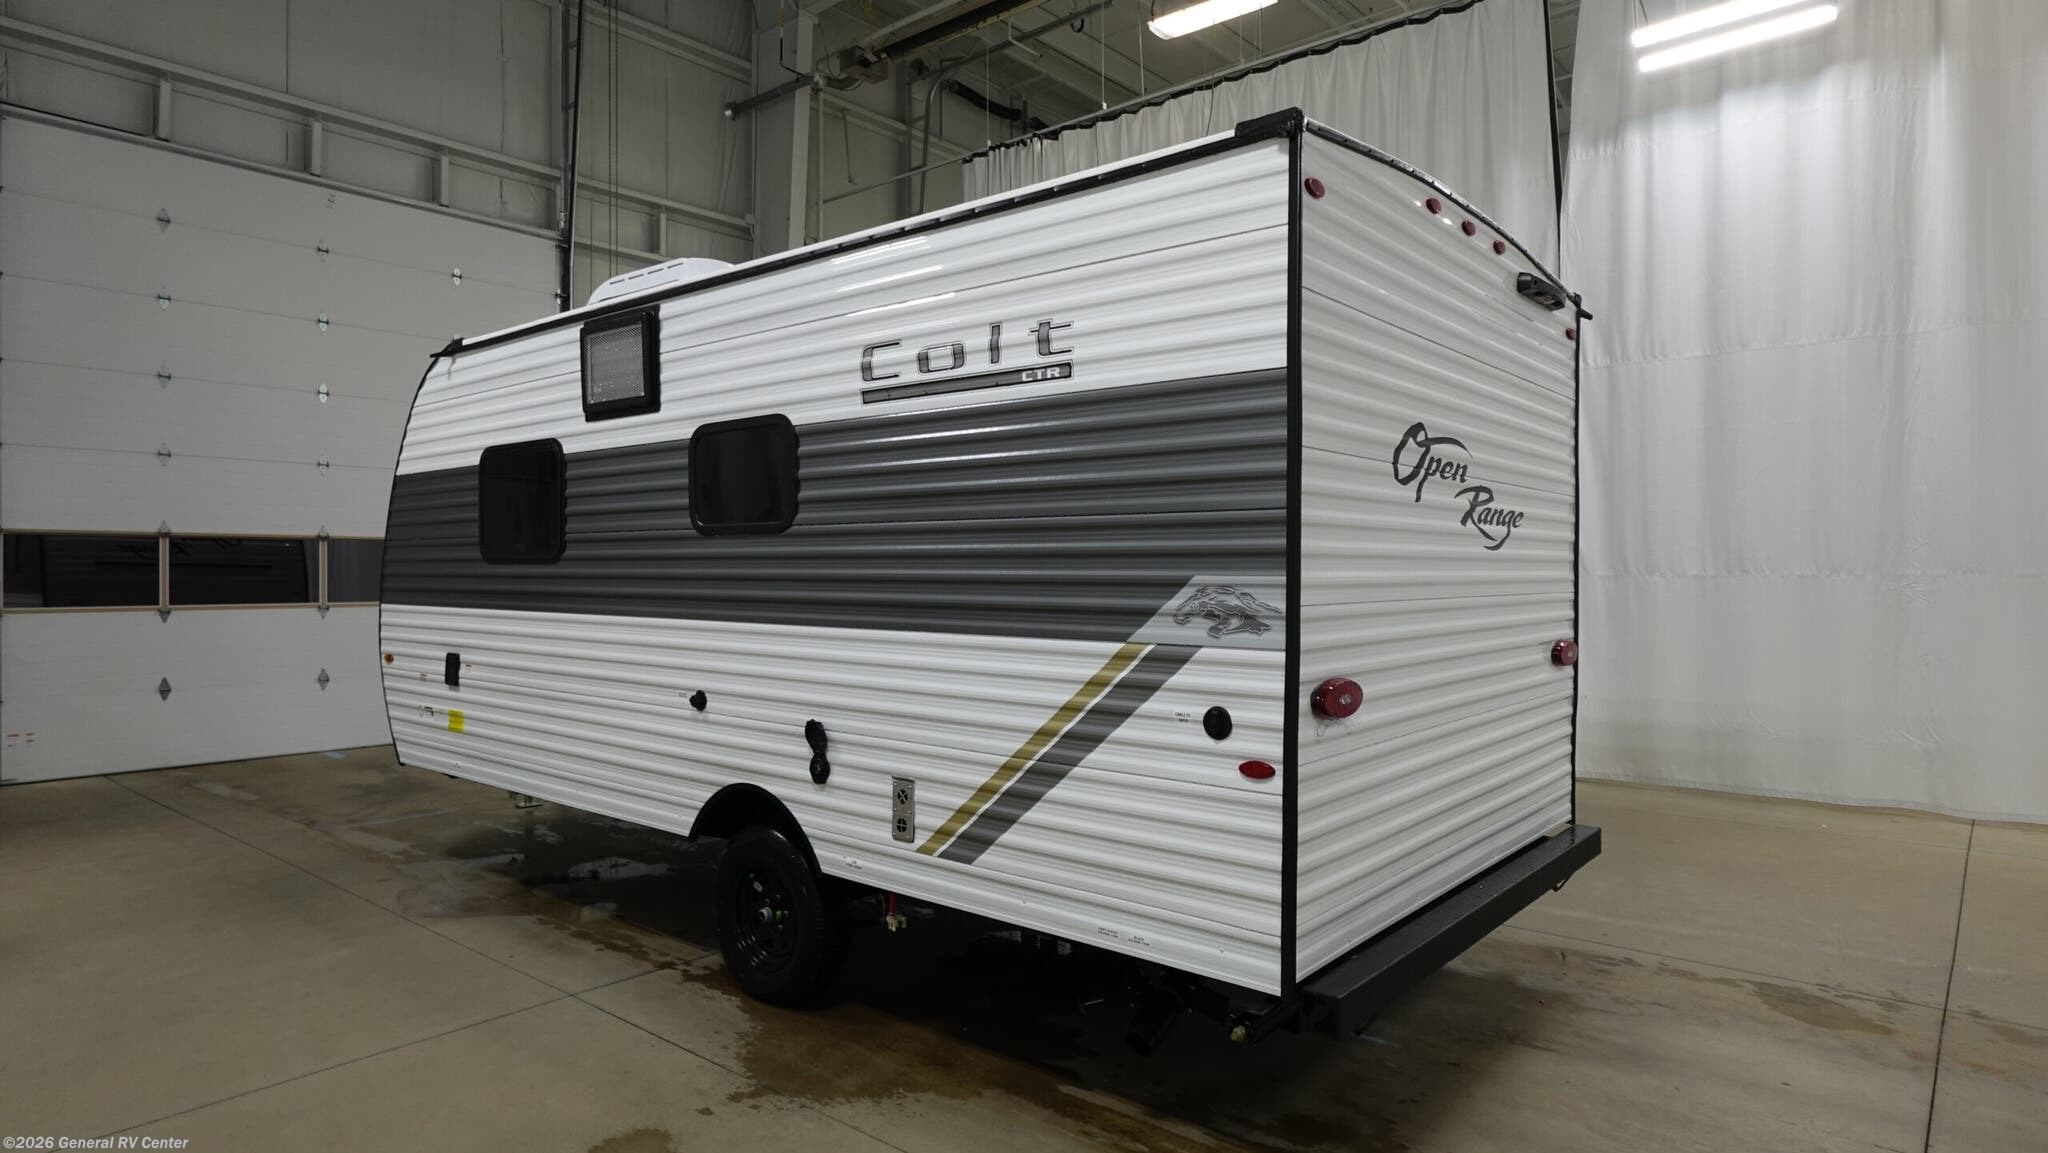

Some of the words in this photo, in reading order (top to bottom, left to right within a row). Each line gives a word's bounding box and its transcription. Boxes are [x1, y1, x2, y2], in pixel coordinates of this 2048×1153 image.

[861, 319, 1074, 382] Colt
[1021, 367, 1061, 382] CTR
[1392, 422, 1473, 503] Open
[1454, 485, 1525, 551] Range
